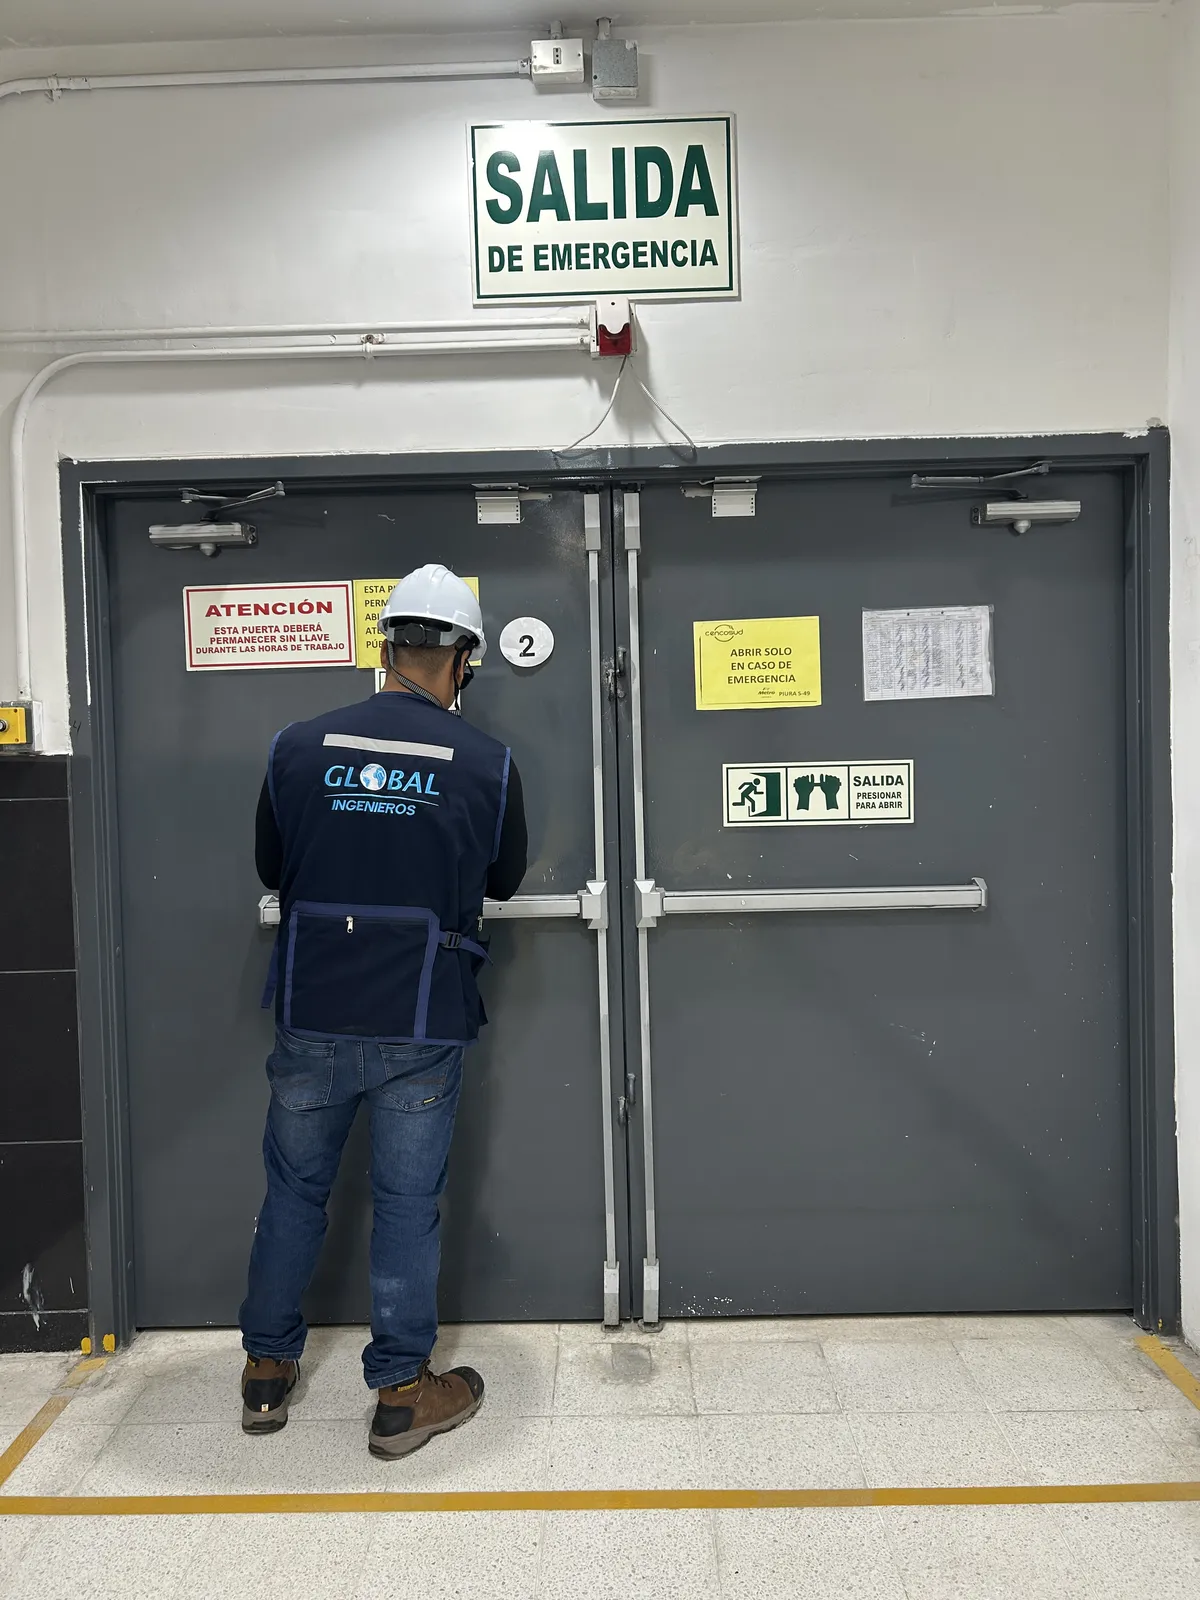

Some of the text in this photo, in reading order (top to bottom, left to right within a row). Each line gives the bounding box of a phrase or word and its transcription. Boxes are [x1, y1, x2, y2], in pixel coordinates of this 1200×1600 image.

[485, 144, 719, 224] SALIDA
[488, 239, 718, 272] DE EMERGENCIA
[364, 585, 385, 594] ESTA
[205, 598, 333, 617] ATENCIÓN
[214, 622, 322, 635] ESTA PUERTA DEBERÁ
[705, 628, 744, 637] cencosud
[210, 633, 330, 645] PERMANECER SIN LLAVE
[196, 646, 237, 654] DURANTE
[239, 645, 256, 653] LAS
[258, 644, 288, 652] HORAS
[304, 642, 345, 651] TRABAJO
[519, 634, 535, 657] 2
[730, 647, 792, 657] ABRIR SOLO
[731, 660, 792, 670] EN CASO DE
[727, 674, 796, 684] EMERGENCIA
[324, 763, 440, 796] GLOBAL
[853, 775, 904, 787] SALIDA
[856, 791, 902, 800] PRESIONAR
[331, 799, 416, 816] INGENIEROS
[856, 801, 903, 809] PARA ABRIR
